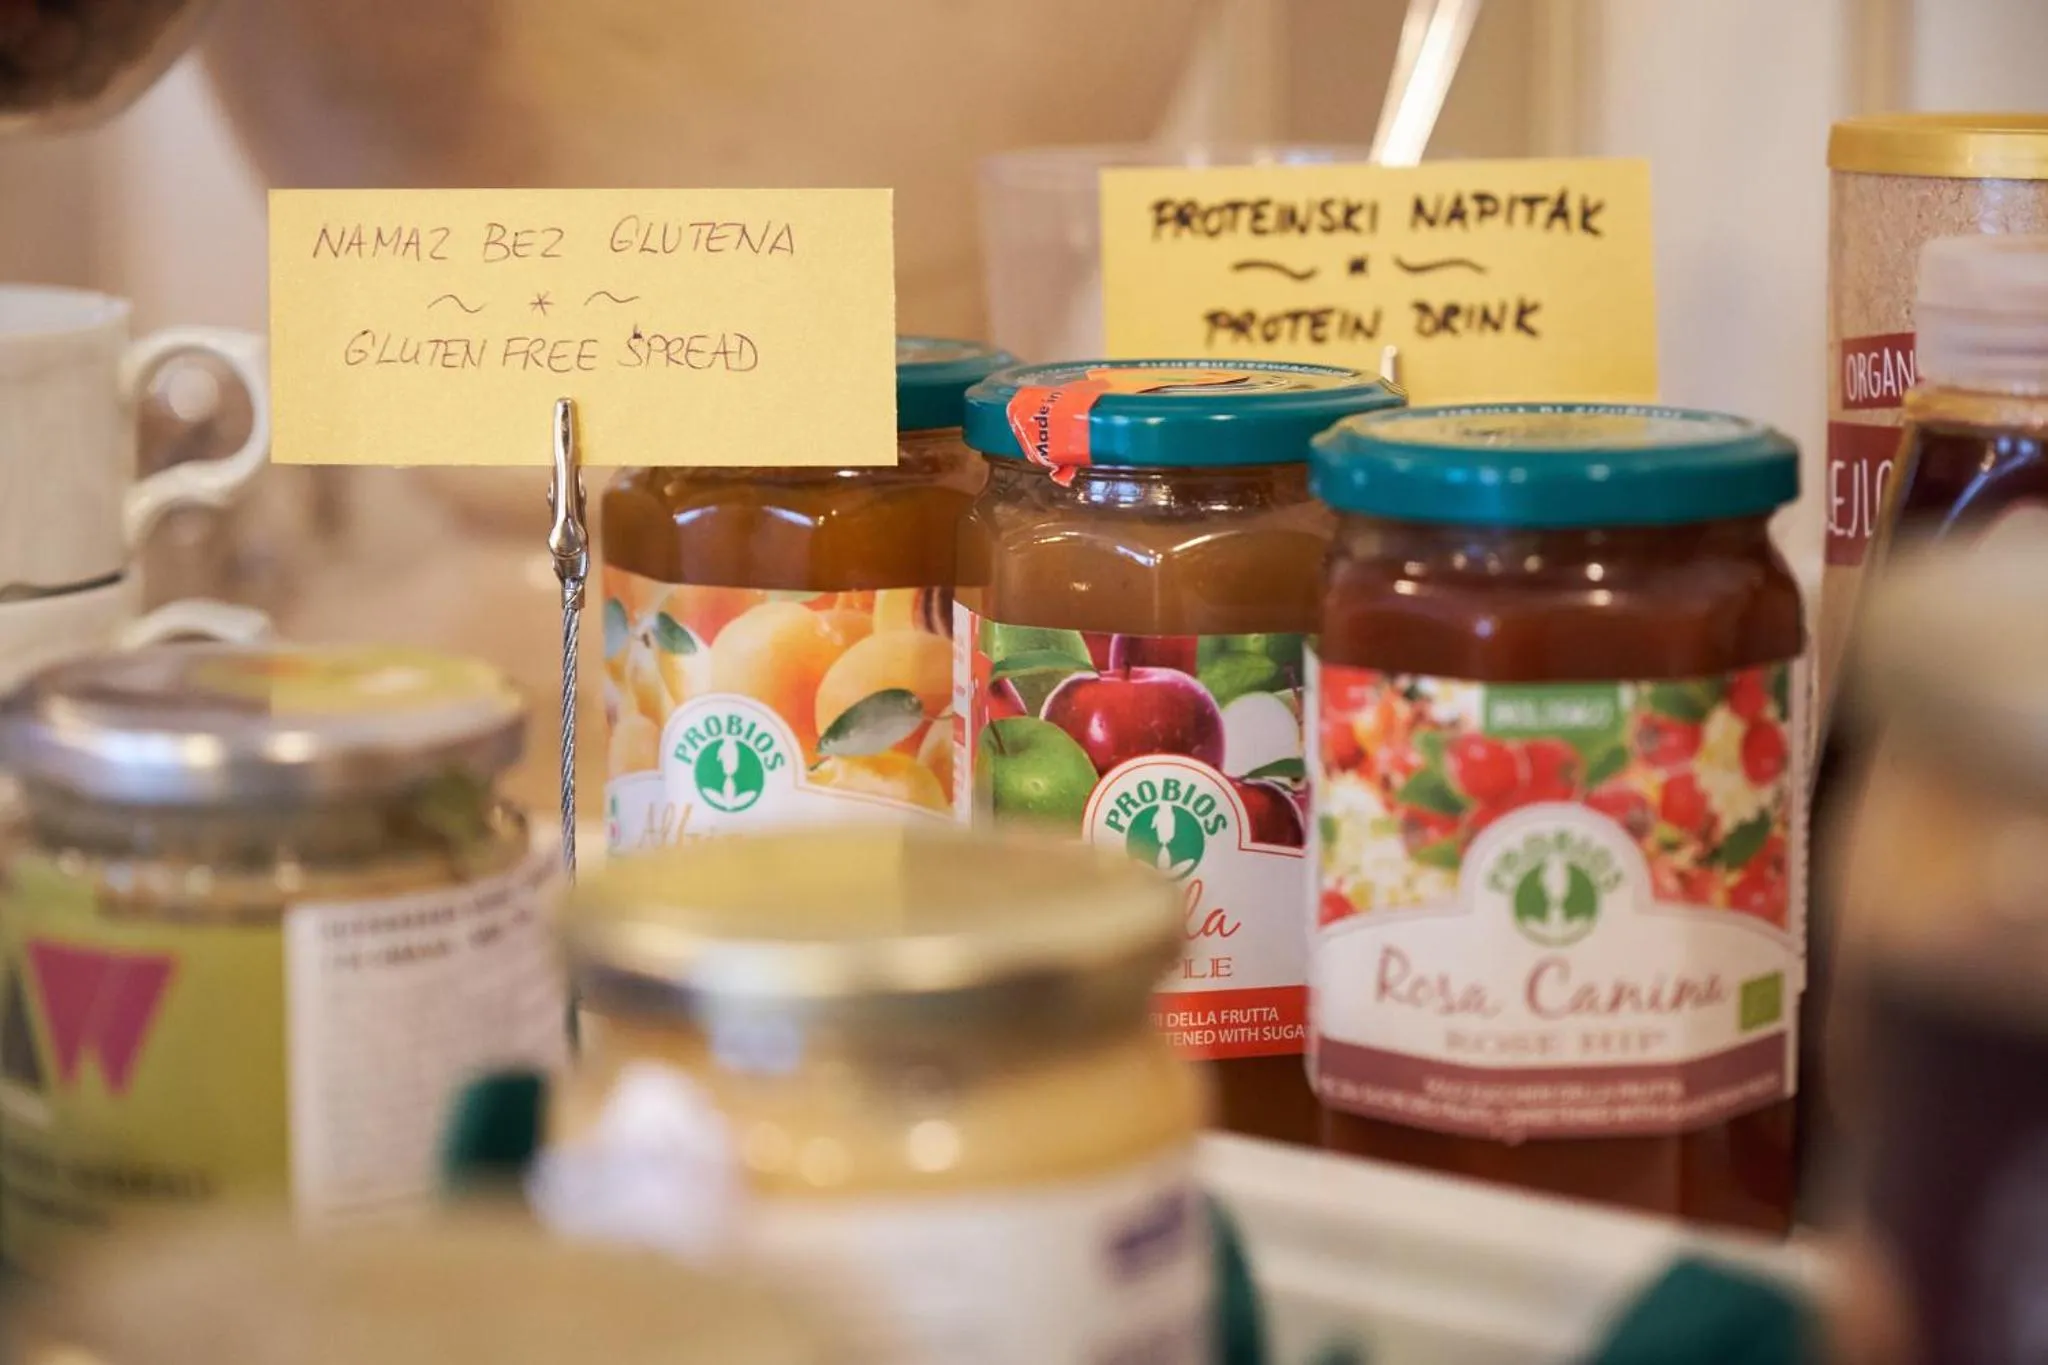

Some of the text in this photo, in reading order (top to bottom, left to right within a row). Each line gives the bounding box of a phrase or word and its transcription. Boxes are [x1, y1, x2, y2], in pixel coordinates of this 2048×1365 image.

[313, 214, 794, 263] NAMAZ BEZ GLUTENA
[1150, 187, 1606, 242] PROTEINSKI NAPITAK
[344, 324, 758, 373] GLUTEN FREE SPREAD
[1203, 298, 1543, 349] PROTEIN DRINK
[1845, 346, 1916, 402] ORGAN
[674, 714, 785, 771] PROBIOS
[1104, 777, 1228, 836] PROBIOS
[1184, 878, 1242, 941] la
[1182, 956, 1234, 979] LE
[1164, 1023, 1308, 1047] TENED WITH SUGA
[1167, 1010, 1217, 1028] DELLA
[1220, 1006, 1279, 1024] FRUTTA
